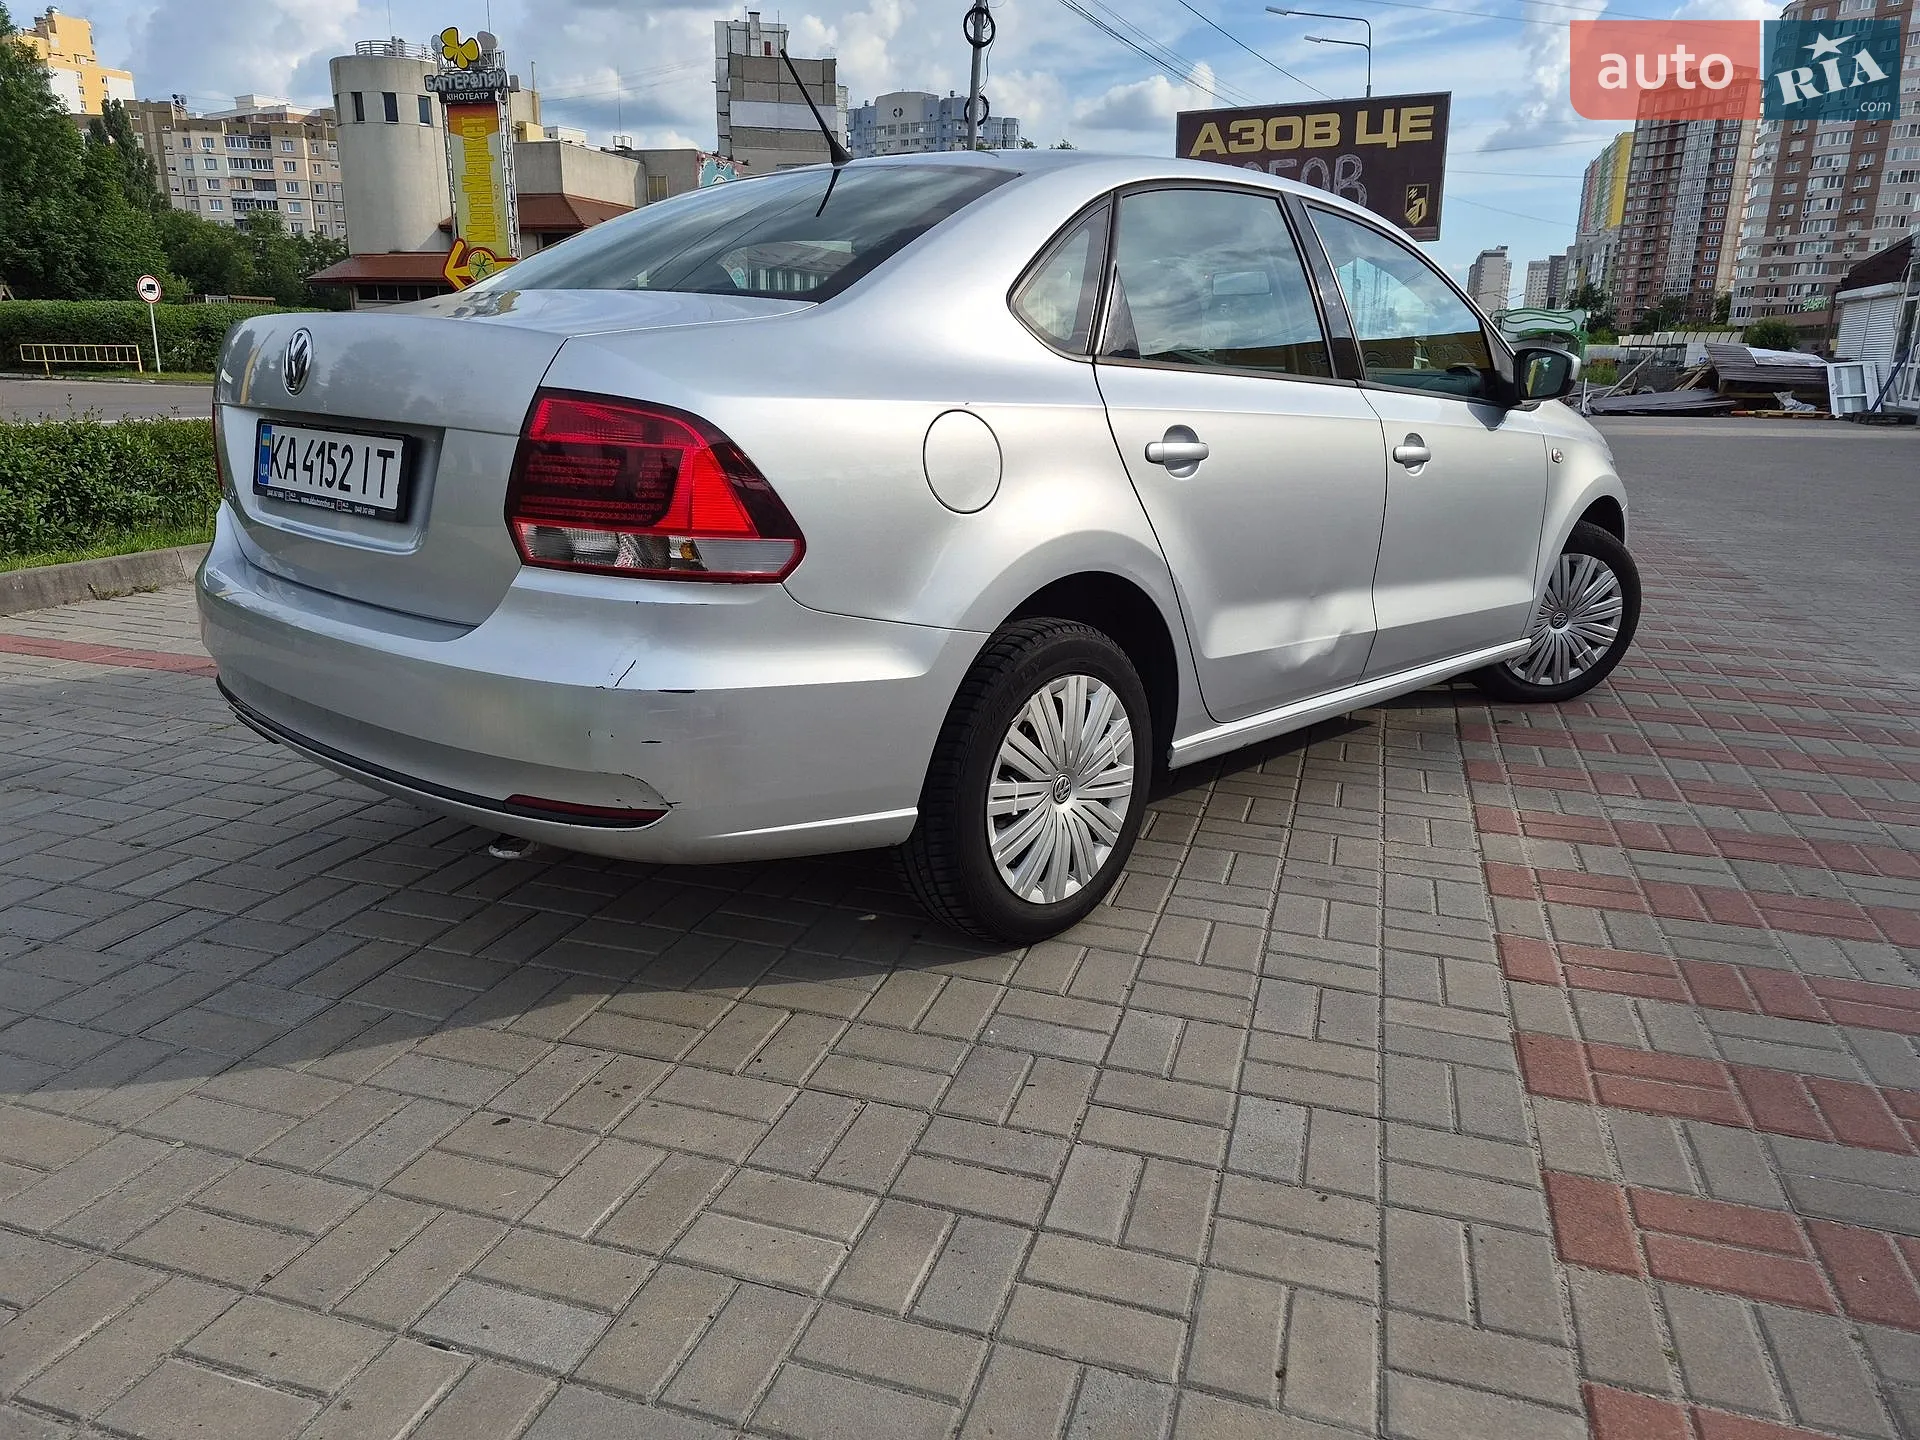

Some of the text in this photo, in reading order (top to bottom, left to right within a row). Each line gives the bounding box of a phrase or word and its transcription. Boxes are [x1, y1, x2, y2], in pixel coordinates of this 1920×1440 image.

[424, 69, 507, 92] БАТТЕРФЛЯЙ
[446, 92, 489, 101] КІНОТЕАТР
[1189, 105, 1434, 157] АЗОВ ЦЕ
[461, 117, 497, 242] МегаМаркет
[270, 434, 297, 482] KA
[302, 439, 353, 493] 4152
